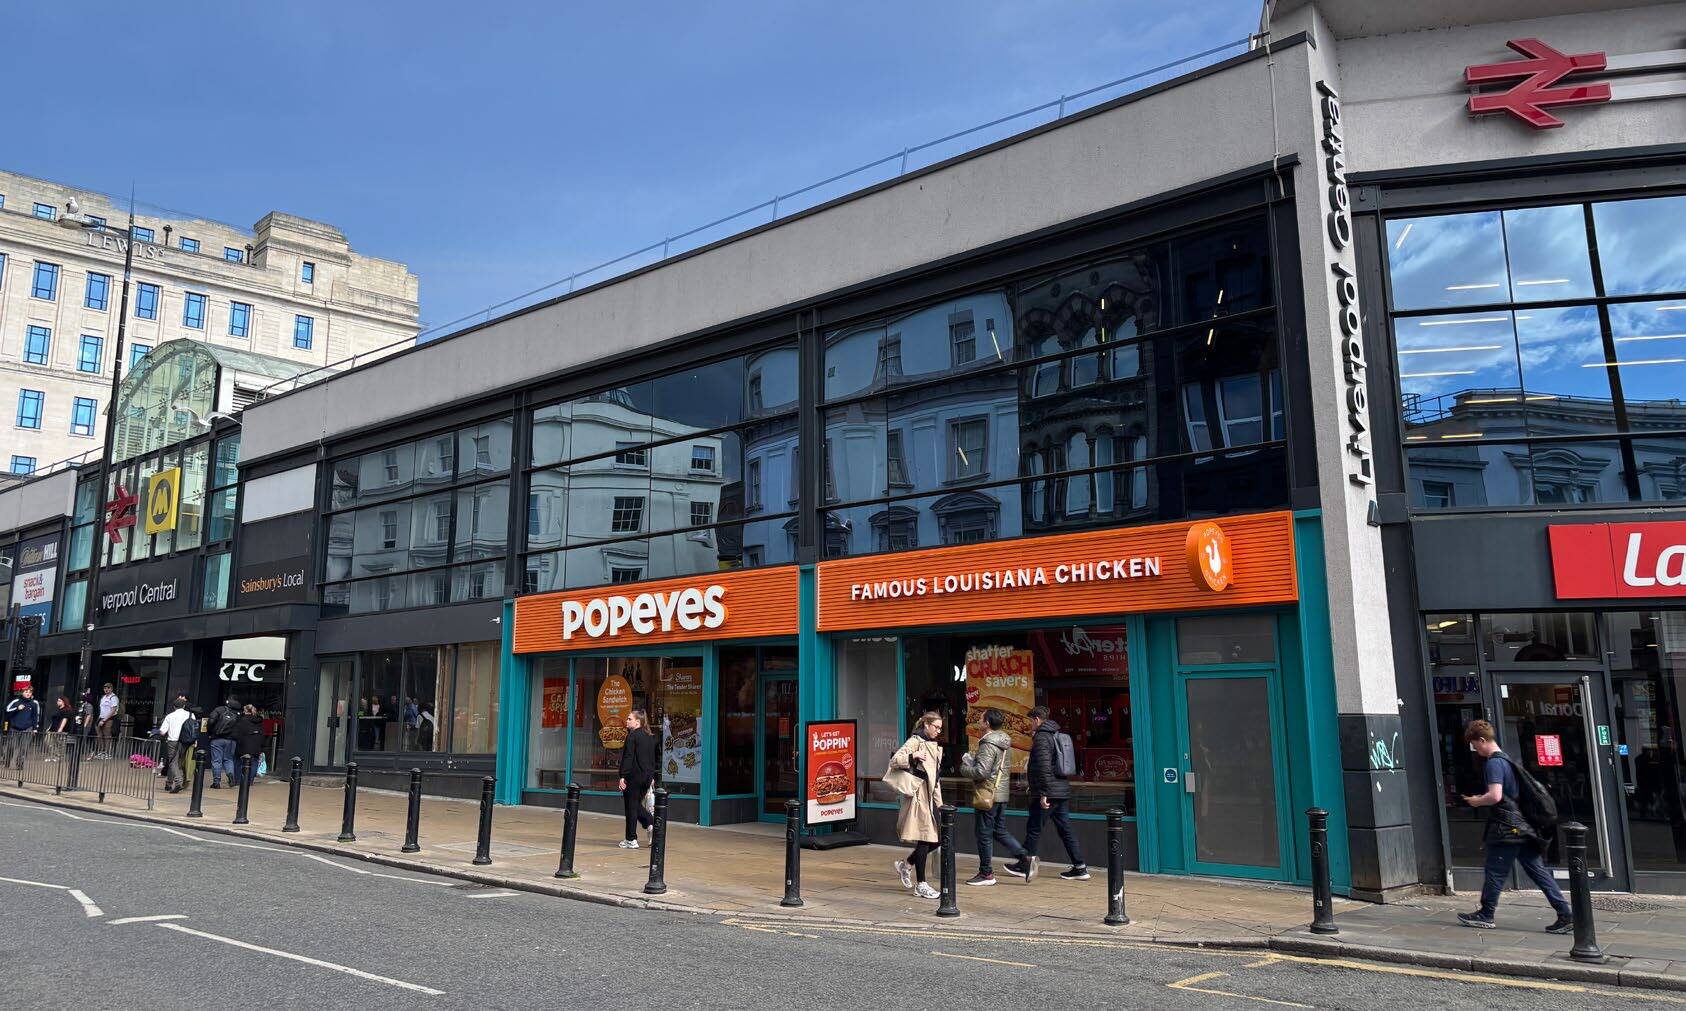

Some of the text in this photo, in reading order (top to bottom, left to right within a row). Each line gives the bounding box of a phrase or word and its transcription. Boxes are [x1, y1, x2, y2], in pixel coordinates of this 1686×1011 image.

[1316, 79, 1374, 490] Liverpool Central
[1623, 532, 1686, 587] La
[241, 569, 304, 593] Sainsbury's Local
[851, 556, 1161, 600] FAMOUS LOUISIANA CHICKEN
[95, 578, 177, 613] verpool Central
[966, 644, 1014, 662] shatter
[219, 662, 266, 682] KFC
[985, 675, 1028, 689] savers
[813, 736, 850, 751] POPPIN'
